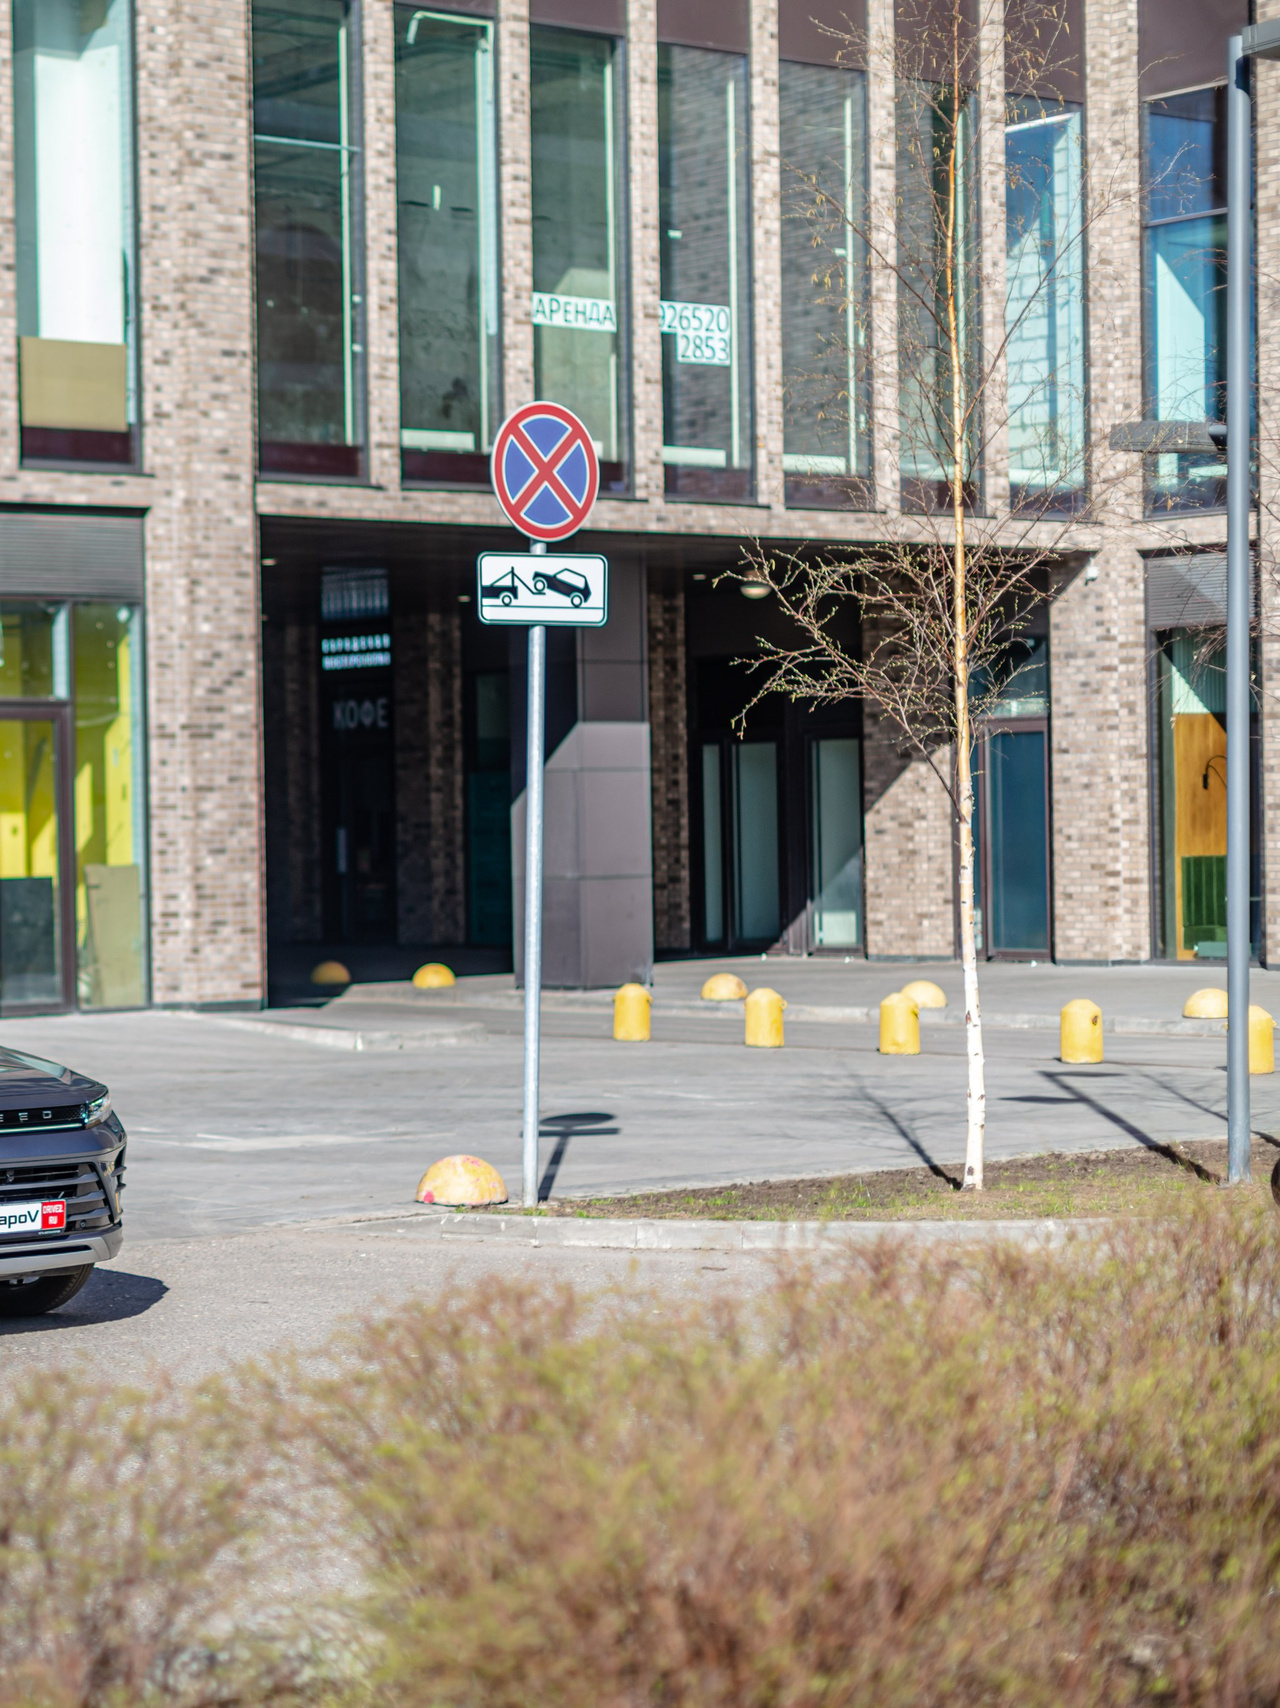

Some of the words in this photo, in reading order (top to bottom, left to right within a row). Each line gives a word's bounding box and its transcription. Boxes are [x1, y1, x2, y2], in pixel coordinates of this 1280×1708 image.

[533, 297, 615, 327] АРЕНДА
[680, 334, 729, 362] 2853
[333, 697, 389, 730] КОФЕ
